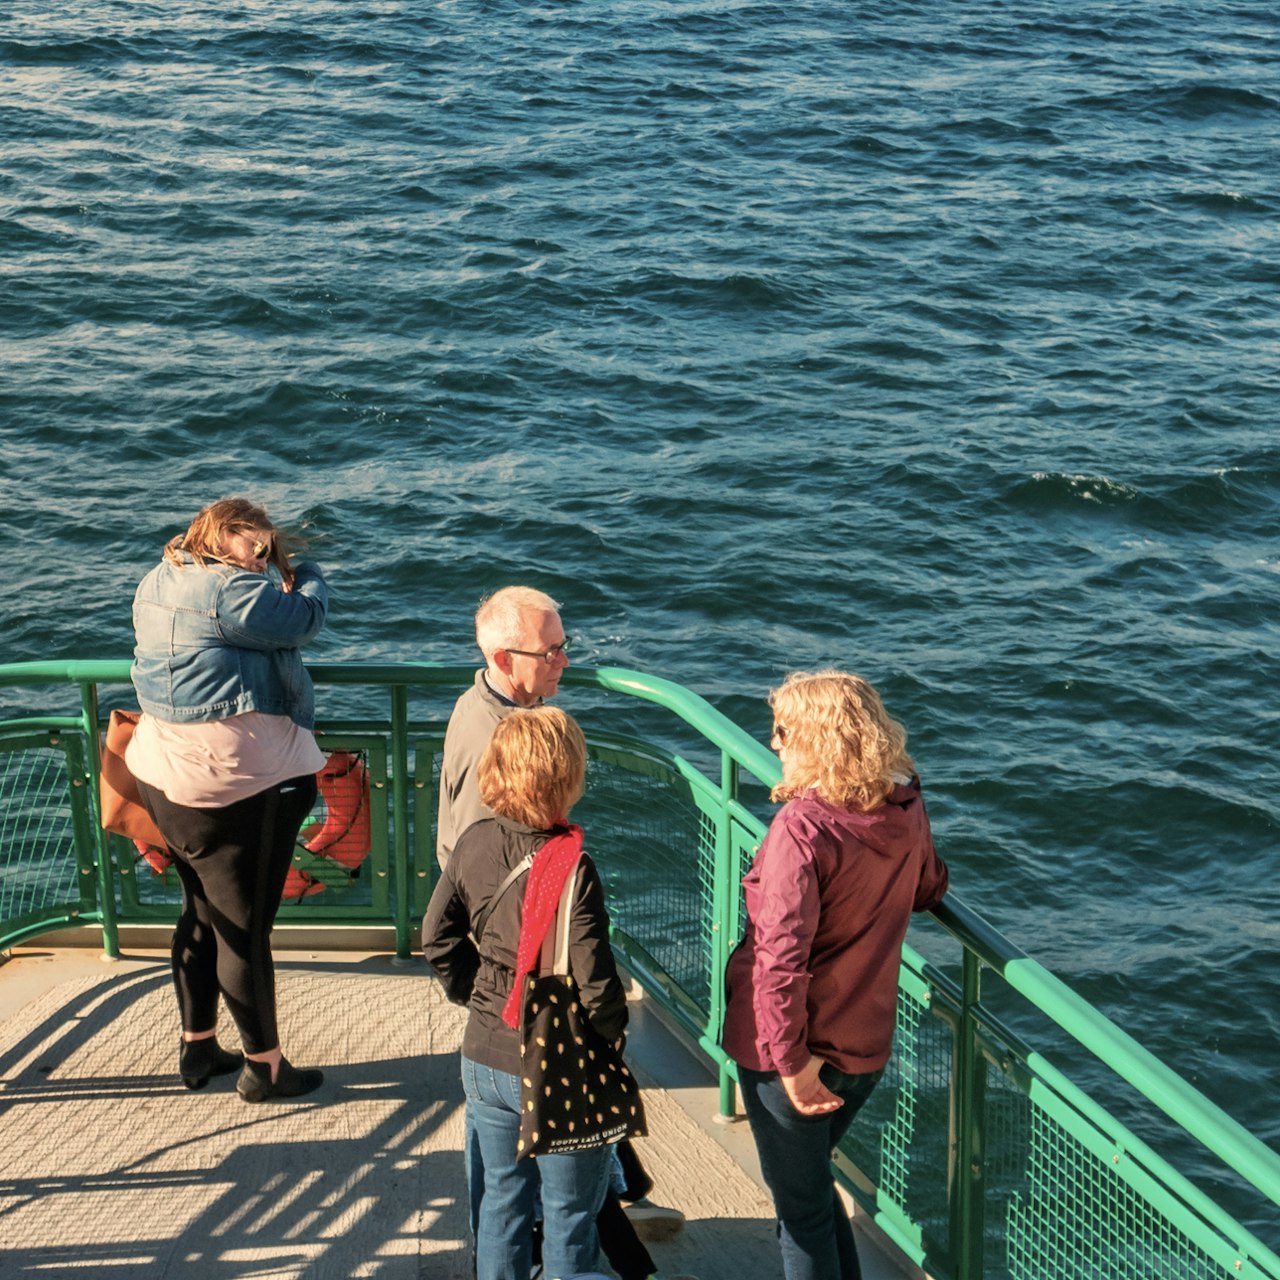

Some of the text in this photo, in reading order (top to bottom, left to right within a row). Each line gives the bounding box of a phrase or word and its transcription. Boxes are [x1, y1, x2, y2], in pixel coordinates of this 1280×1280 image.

[550, 1123, 628, 1147] SOUTH LAKE UNION
[547, 1141, 603, 1154] BLOCK PARTY
